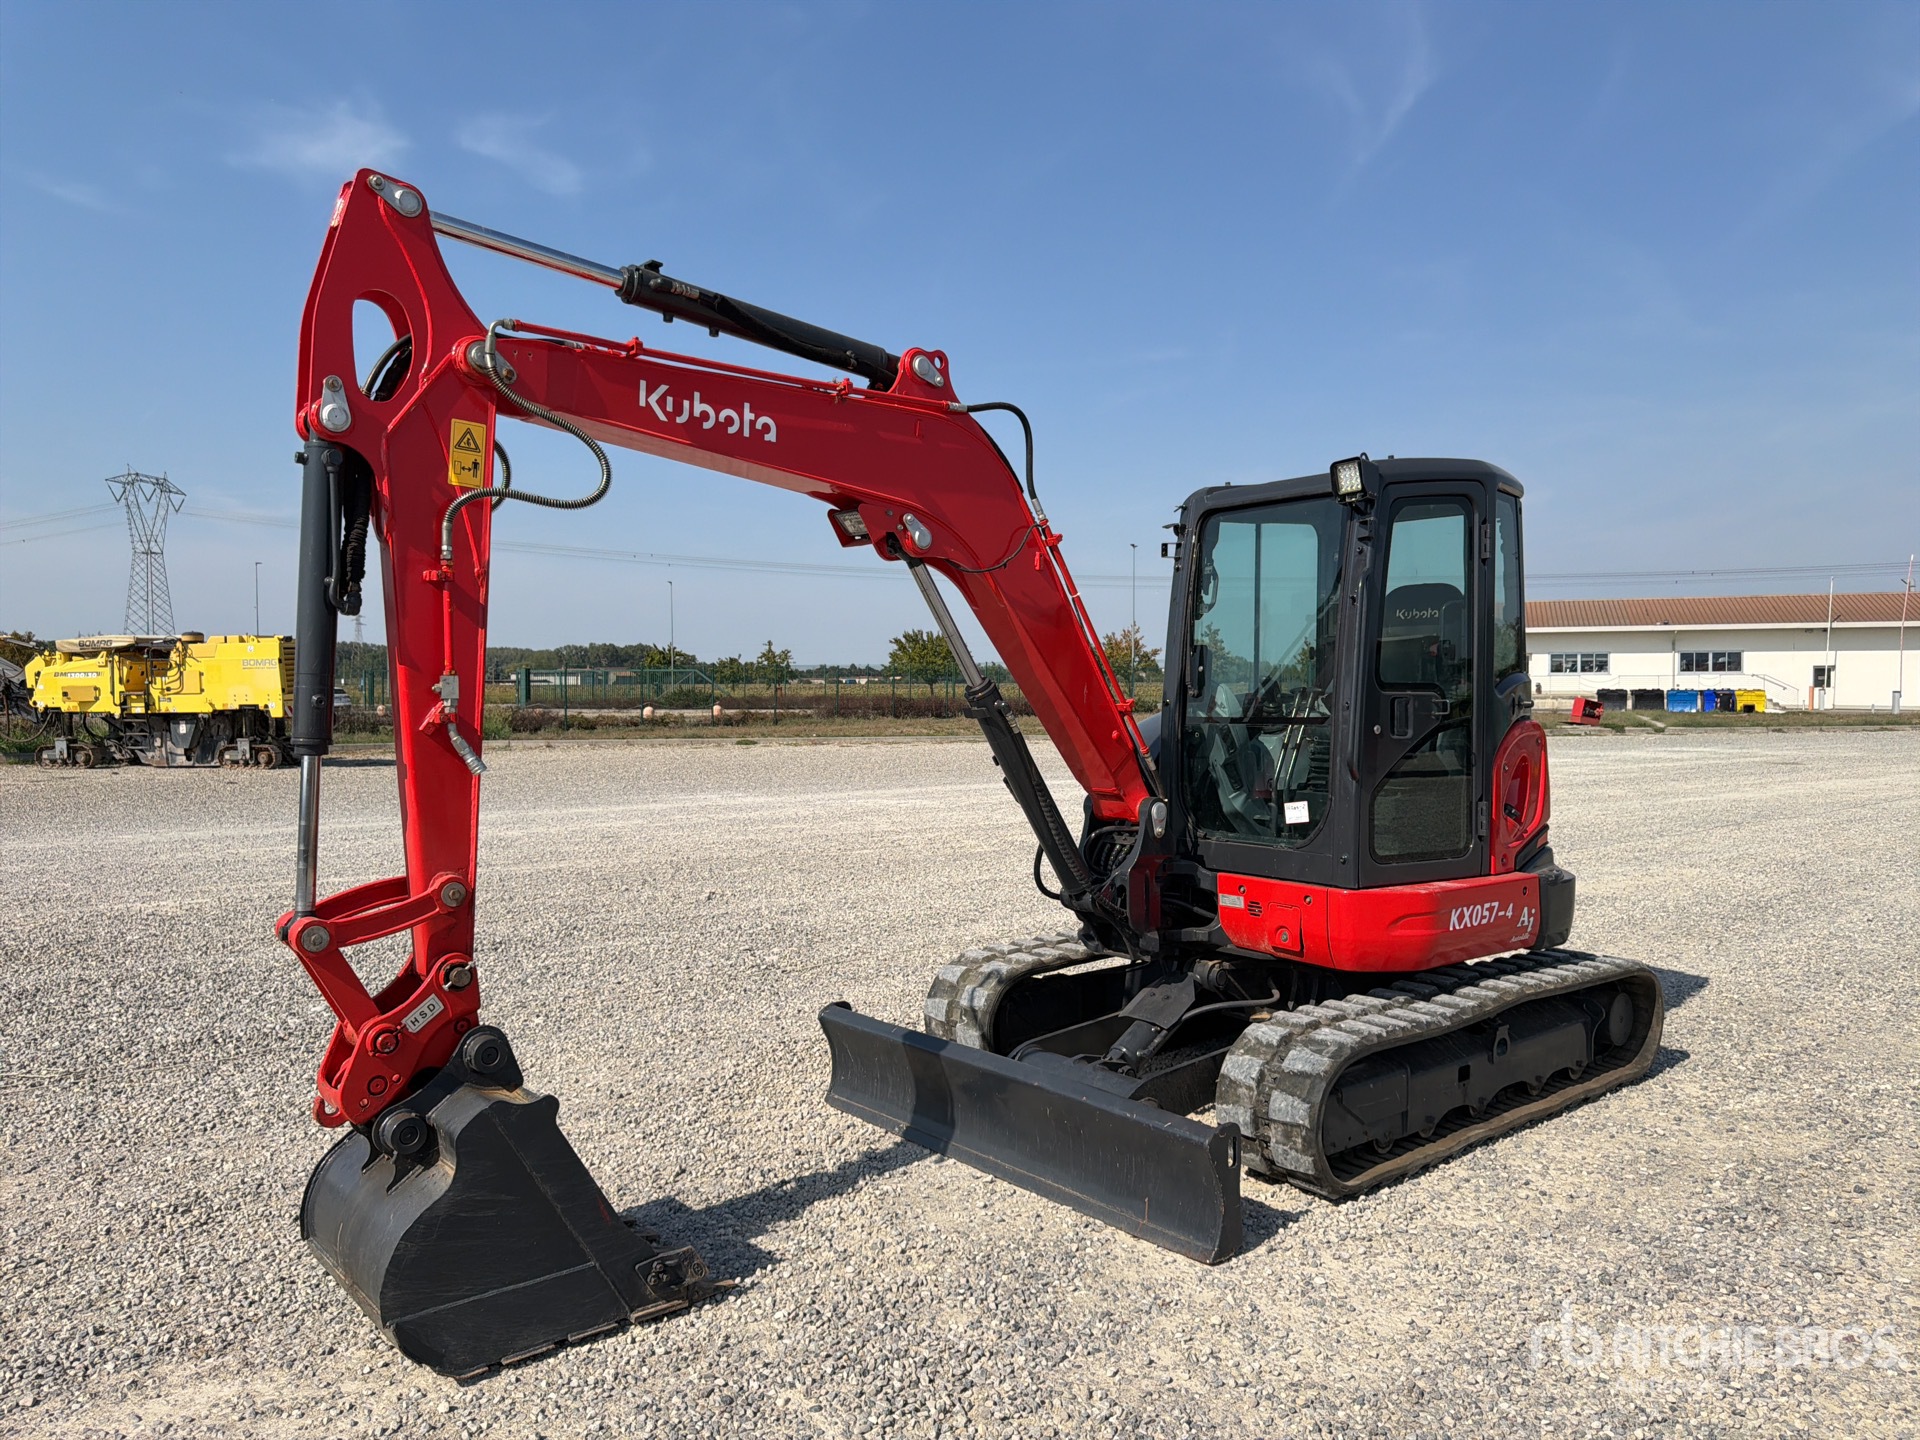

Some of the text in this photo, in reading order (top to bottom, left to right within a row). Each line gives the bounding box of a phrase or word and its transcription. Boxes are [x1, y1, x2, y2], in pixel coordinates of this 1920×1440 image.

[639, 379, 776, 442] Kubota
[1396, 608, 1439, 619] Kubota
[79, 640, 113, 648] BOMAG
[242, 659, 277, 667] BOMAG
[1449, 902, 1513, 931] KX057-4
